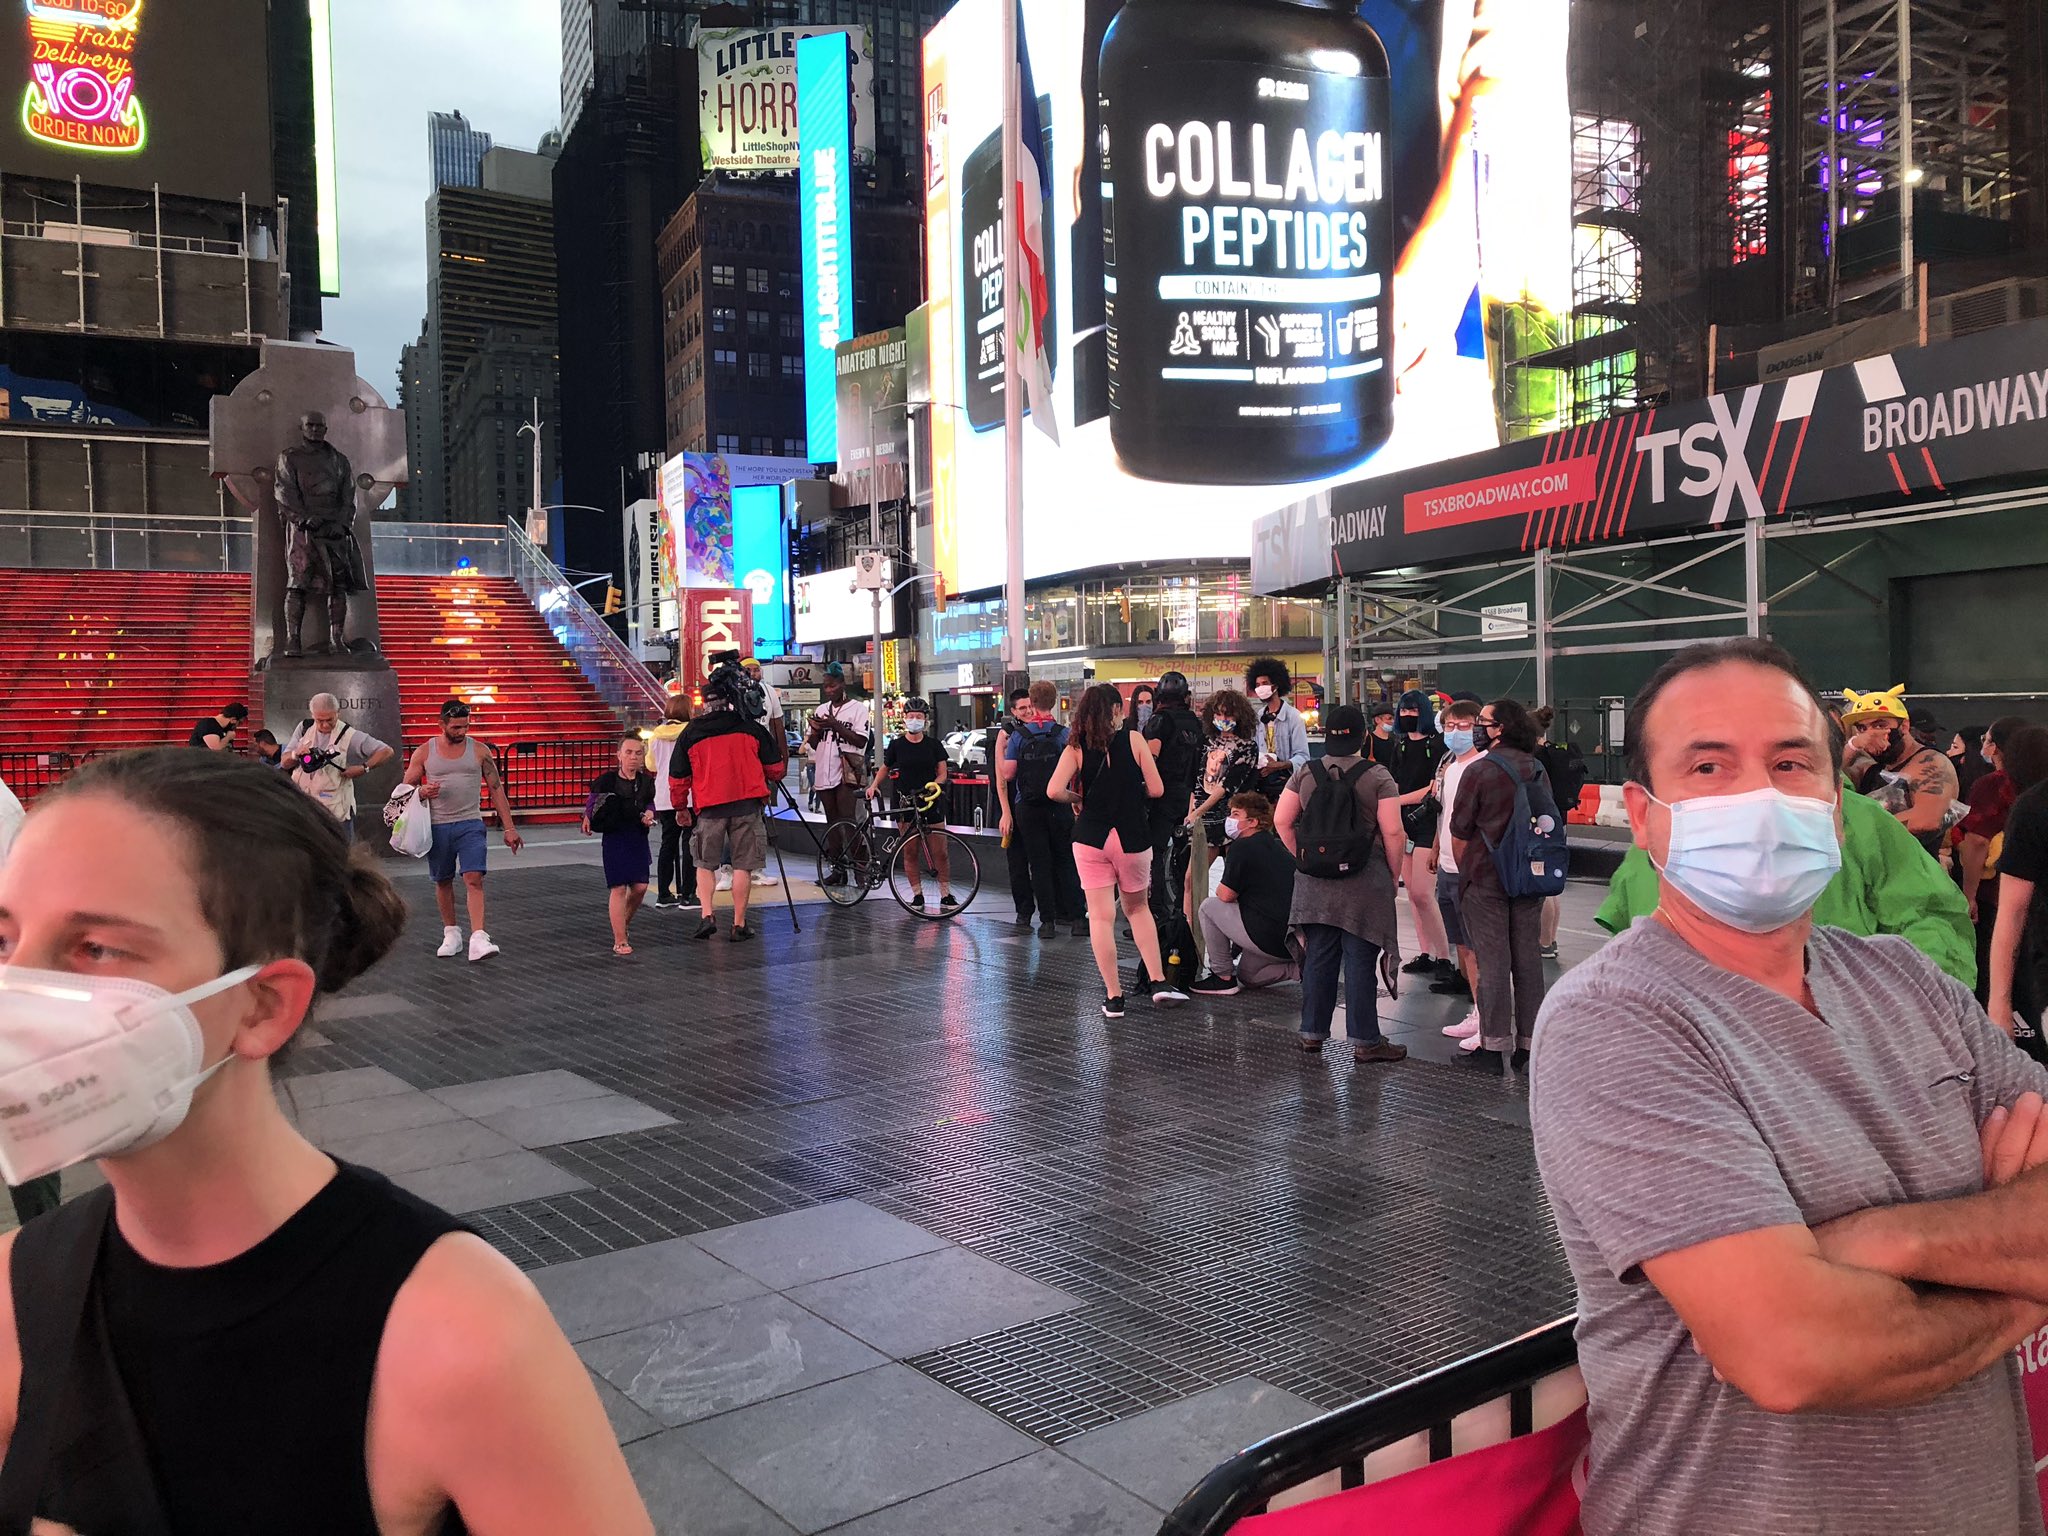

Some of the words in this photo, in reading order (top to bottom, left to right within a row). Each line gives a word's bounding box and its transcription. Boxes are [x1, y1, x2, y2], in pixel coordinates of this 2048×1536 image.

[33, 0, 73, 9] OD
[79, 23, 135, 51] Fast
[33, 40, 132, 84] Delivery
[716, 31, 795, 77] LITTLE
[775, 65, 792, 75] OF
[30, 113, 87, 141] ORDER
[92, 124, 138, 144] NOW!
[717, 81, 798, 154] HORR
[711, 154, 754, 166] Westside
[755, 153, 791, 165] Theatre
[742, 141, 800, 153] LittleShopNY
[1145, 120, 1383, 204] COLLAGEN
[974, 218, 1004, 278] COLL
[1182, 205, 1368, 271] PEPTIDES
[1194, 280, 1256, 296] CONTAIN
[1192, 310, 1237, 326] HEALTHY
[836, 347, 877, 376] AMATEUR
[879, 340, 907, 366] NIGHT
[1765, 350, 1825, 375] DOOSAN
[850, 447, 866, 461] EVERY
[1636, 383, 1767, 525] TSX
[1863, 368, 2048, 453] BROADWAY
[779, 467, 814, 475] UNDERSTAN
[1423, 472, 1569, 517] TSXBROADWAY.COM
[1328, 504, 1388, 547] OADWAY
[1497, 606, 1524, 614] Broadway
[885, 641, 894, 681] LUGGAGE
[1138, 660, 1165, 677] The
[1165, 660, 1213, 674] Plastic
[1214, 658, 1244, 675] Bag
[339, 698, 386, 710] DUFFY
